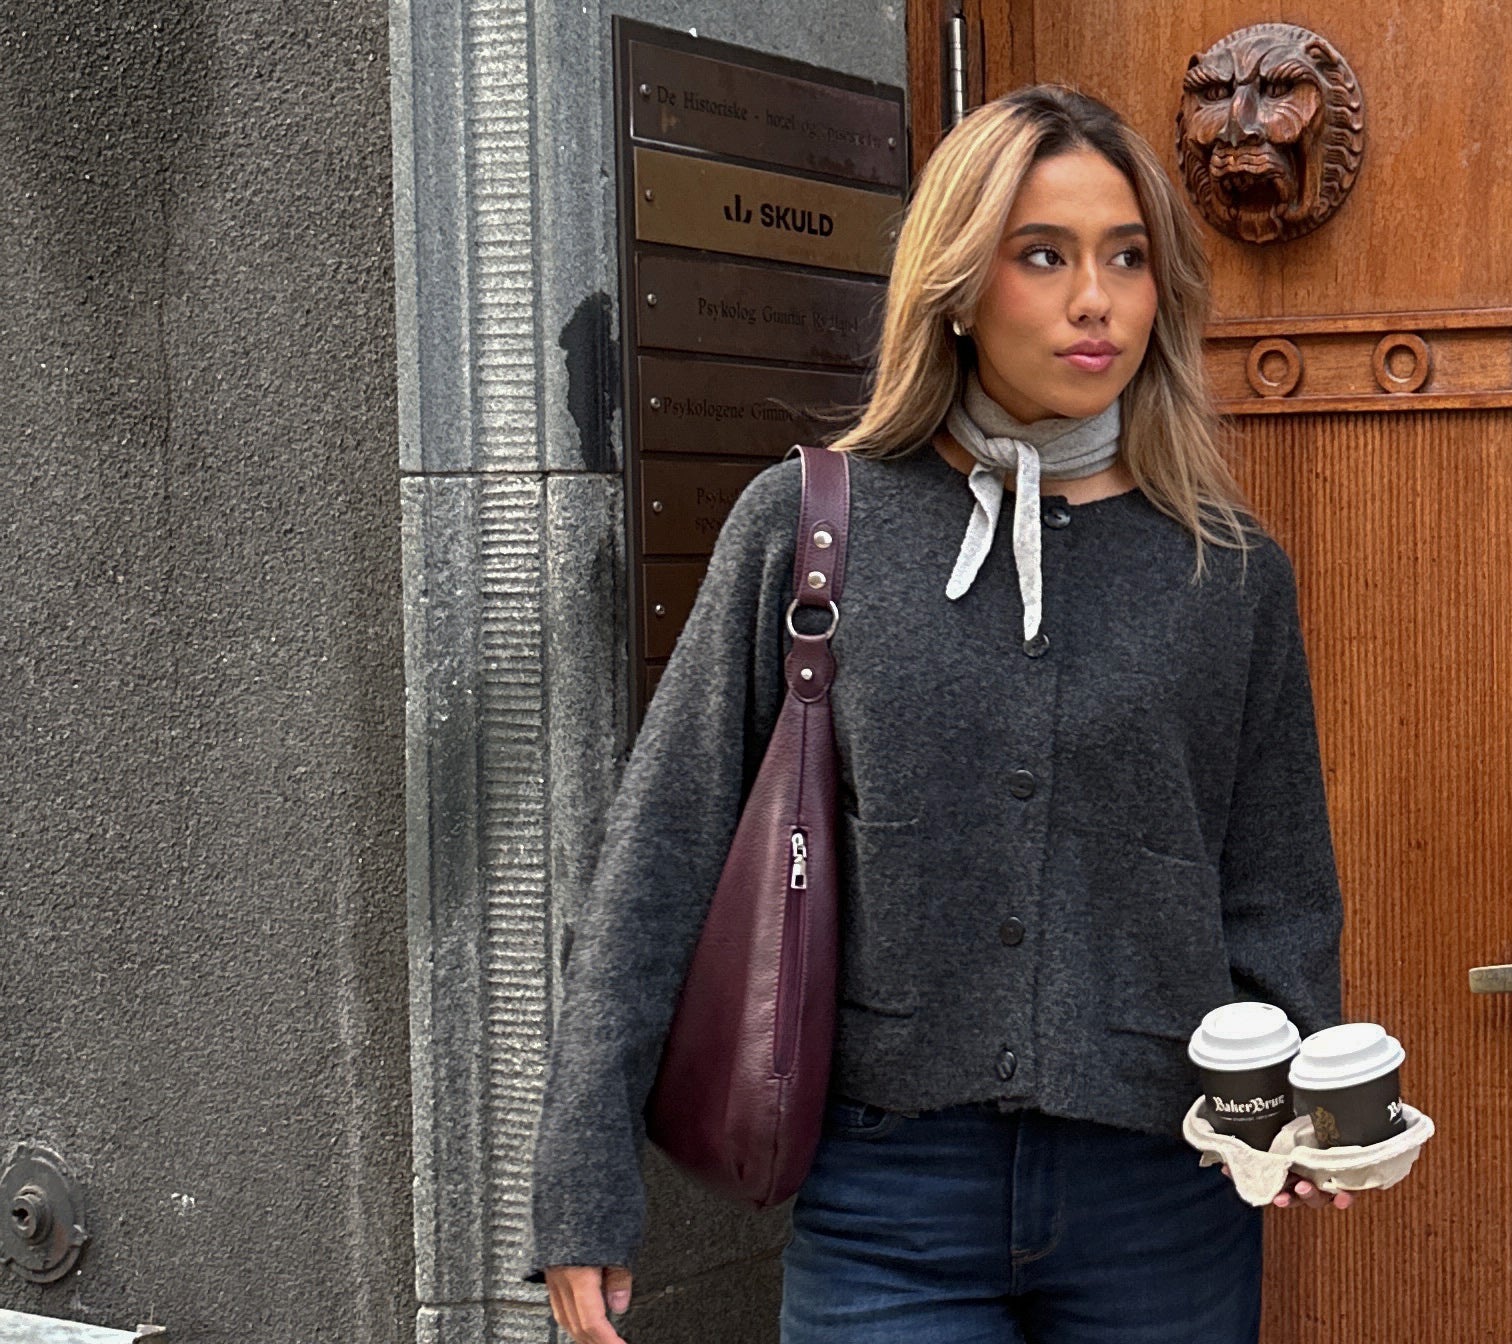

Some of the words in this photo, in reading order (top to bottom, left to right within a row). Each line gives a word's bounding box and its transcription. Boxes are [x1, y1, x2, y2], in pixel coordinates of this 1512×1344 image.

[656, 85, 677, 106] De
[683, 90, 748, 121] Historiske
[760, 203, 834, 237] SKULD
[698, 297, 756, 325] Psykolog
[662, 396, 745, 422] Psykologene
